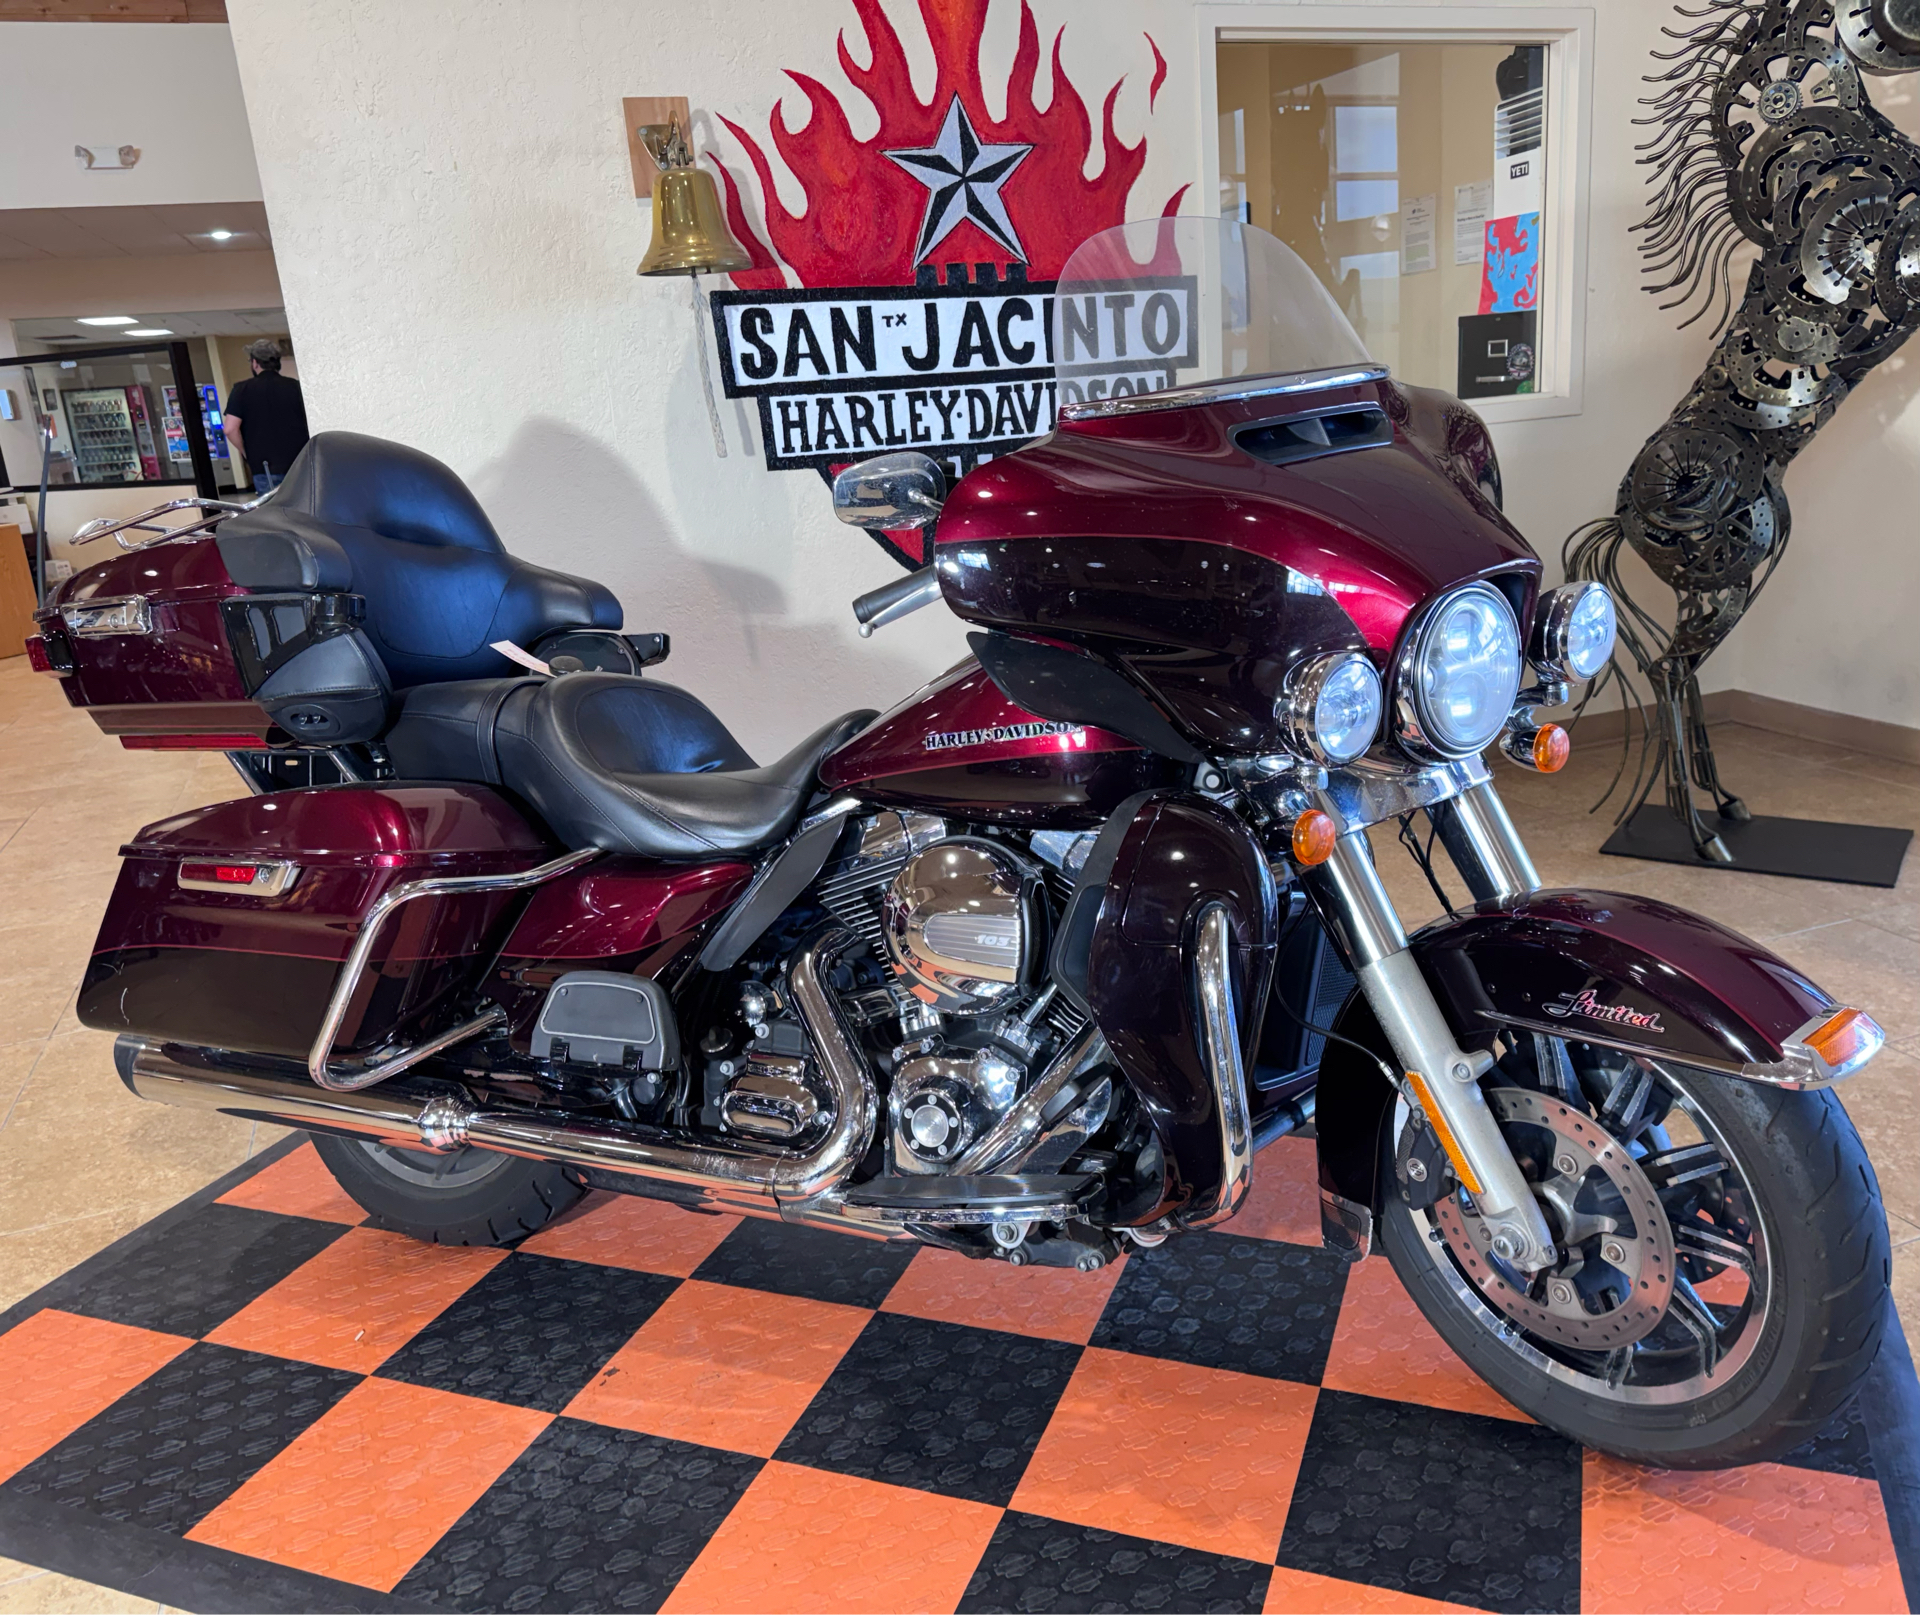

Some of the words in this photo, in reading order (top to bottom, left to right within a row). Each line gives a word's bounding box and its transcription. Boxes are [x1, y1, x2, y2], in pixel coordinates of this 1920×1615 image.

[1511, 163, 1528, 177] YETI
[740, 305, 876, 380] SAN
[881, 312, 907, 328] TX
[902, 292, 1181, 372] JACINTO
[977, 933, 1011, 948] 103
[1541, 989, 1666, 1034] Limited
